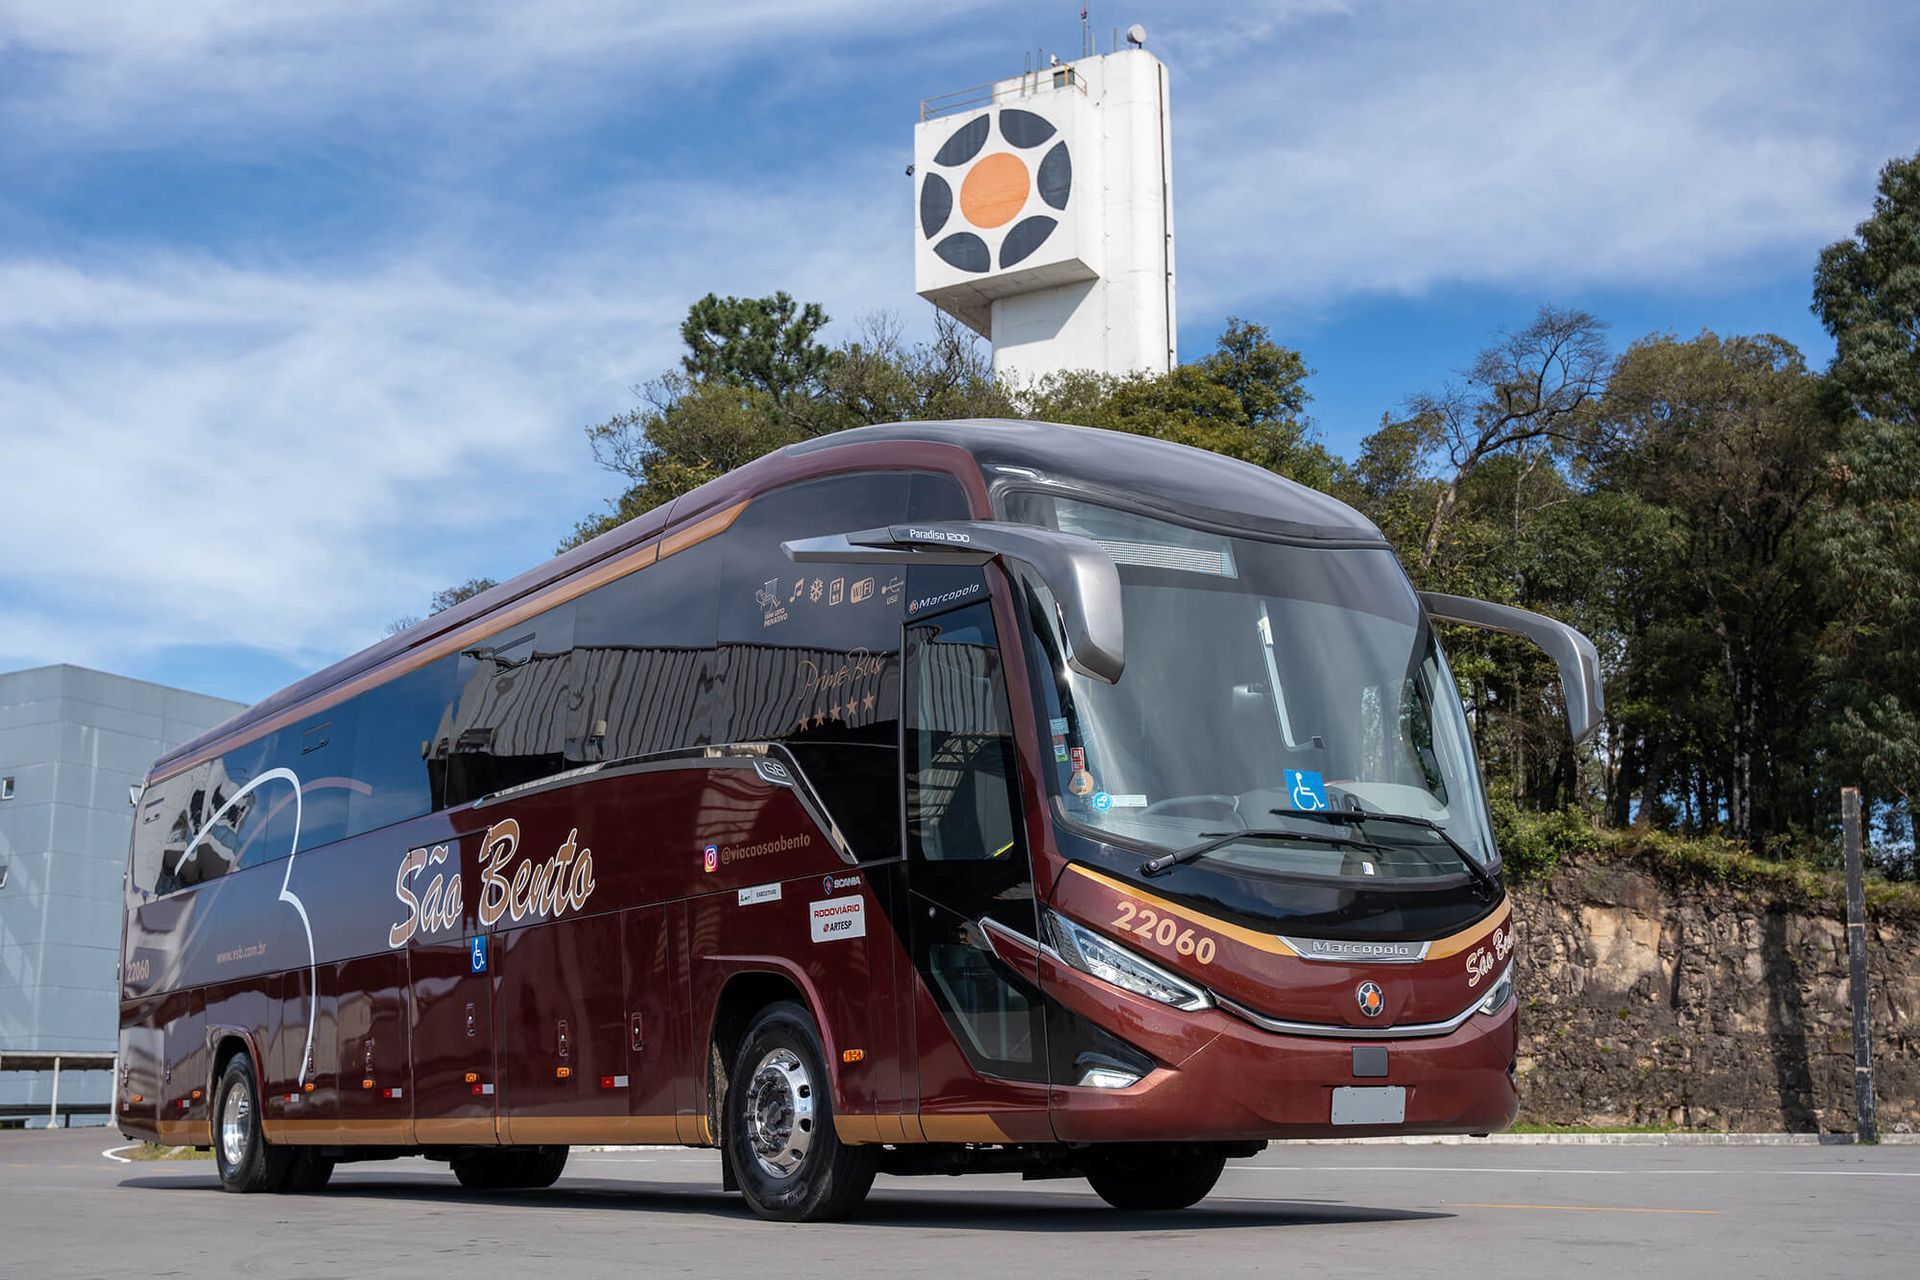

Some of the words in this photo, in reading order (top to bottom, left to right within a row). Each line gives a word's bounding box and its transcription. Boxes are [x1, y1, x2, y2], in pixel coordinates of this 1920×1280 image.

[910, 528, 945, 540] Paradiso
[946, 532, 970, 543] 1200
[919, 584, 980, 608] Marcopolo
[763, 761, 787, 777] G8
[721, 833, 811, 865] @viacaosaobento
[389, 845, 464, 948] São
[479, 818, 596, 926] Bento
[834, 876, 861, 888] SCANIA
[830, 920, 852, 932] ARTESP
[1111, 901, 1216, 965] 22060
[1312, 941, 1409, 955] Marcopolo
[127, 960, 149, 982] 22060
[1466, 947, 1494, 987] São
